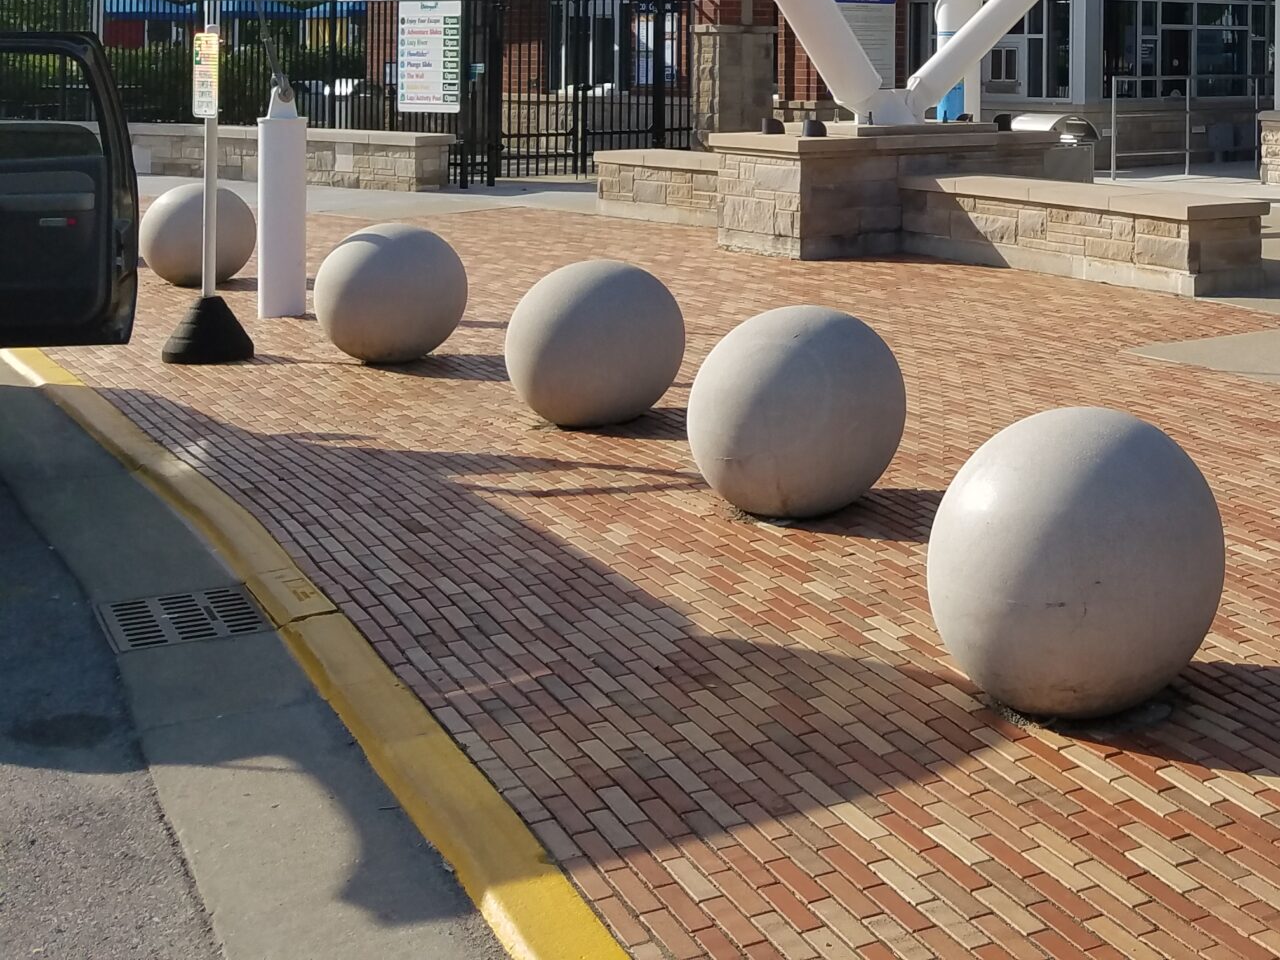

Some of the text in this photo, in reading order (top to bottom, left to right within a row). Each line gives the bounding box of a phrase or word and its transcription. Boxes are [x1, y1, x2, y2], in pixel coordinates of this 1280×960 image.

[444, 17, 458, 26] Open
[444, 28, 458, 37] Open
[444, 39, 458, 48] Open
[444, 50, 458, 59] Open
[444, 61, 458, 70] Open
[444, 72, 457, 81] Open
[444, 94, 457, 103] Open
